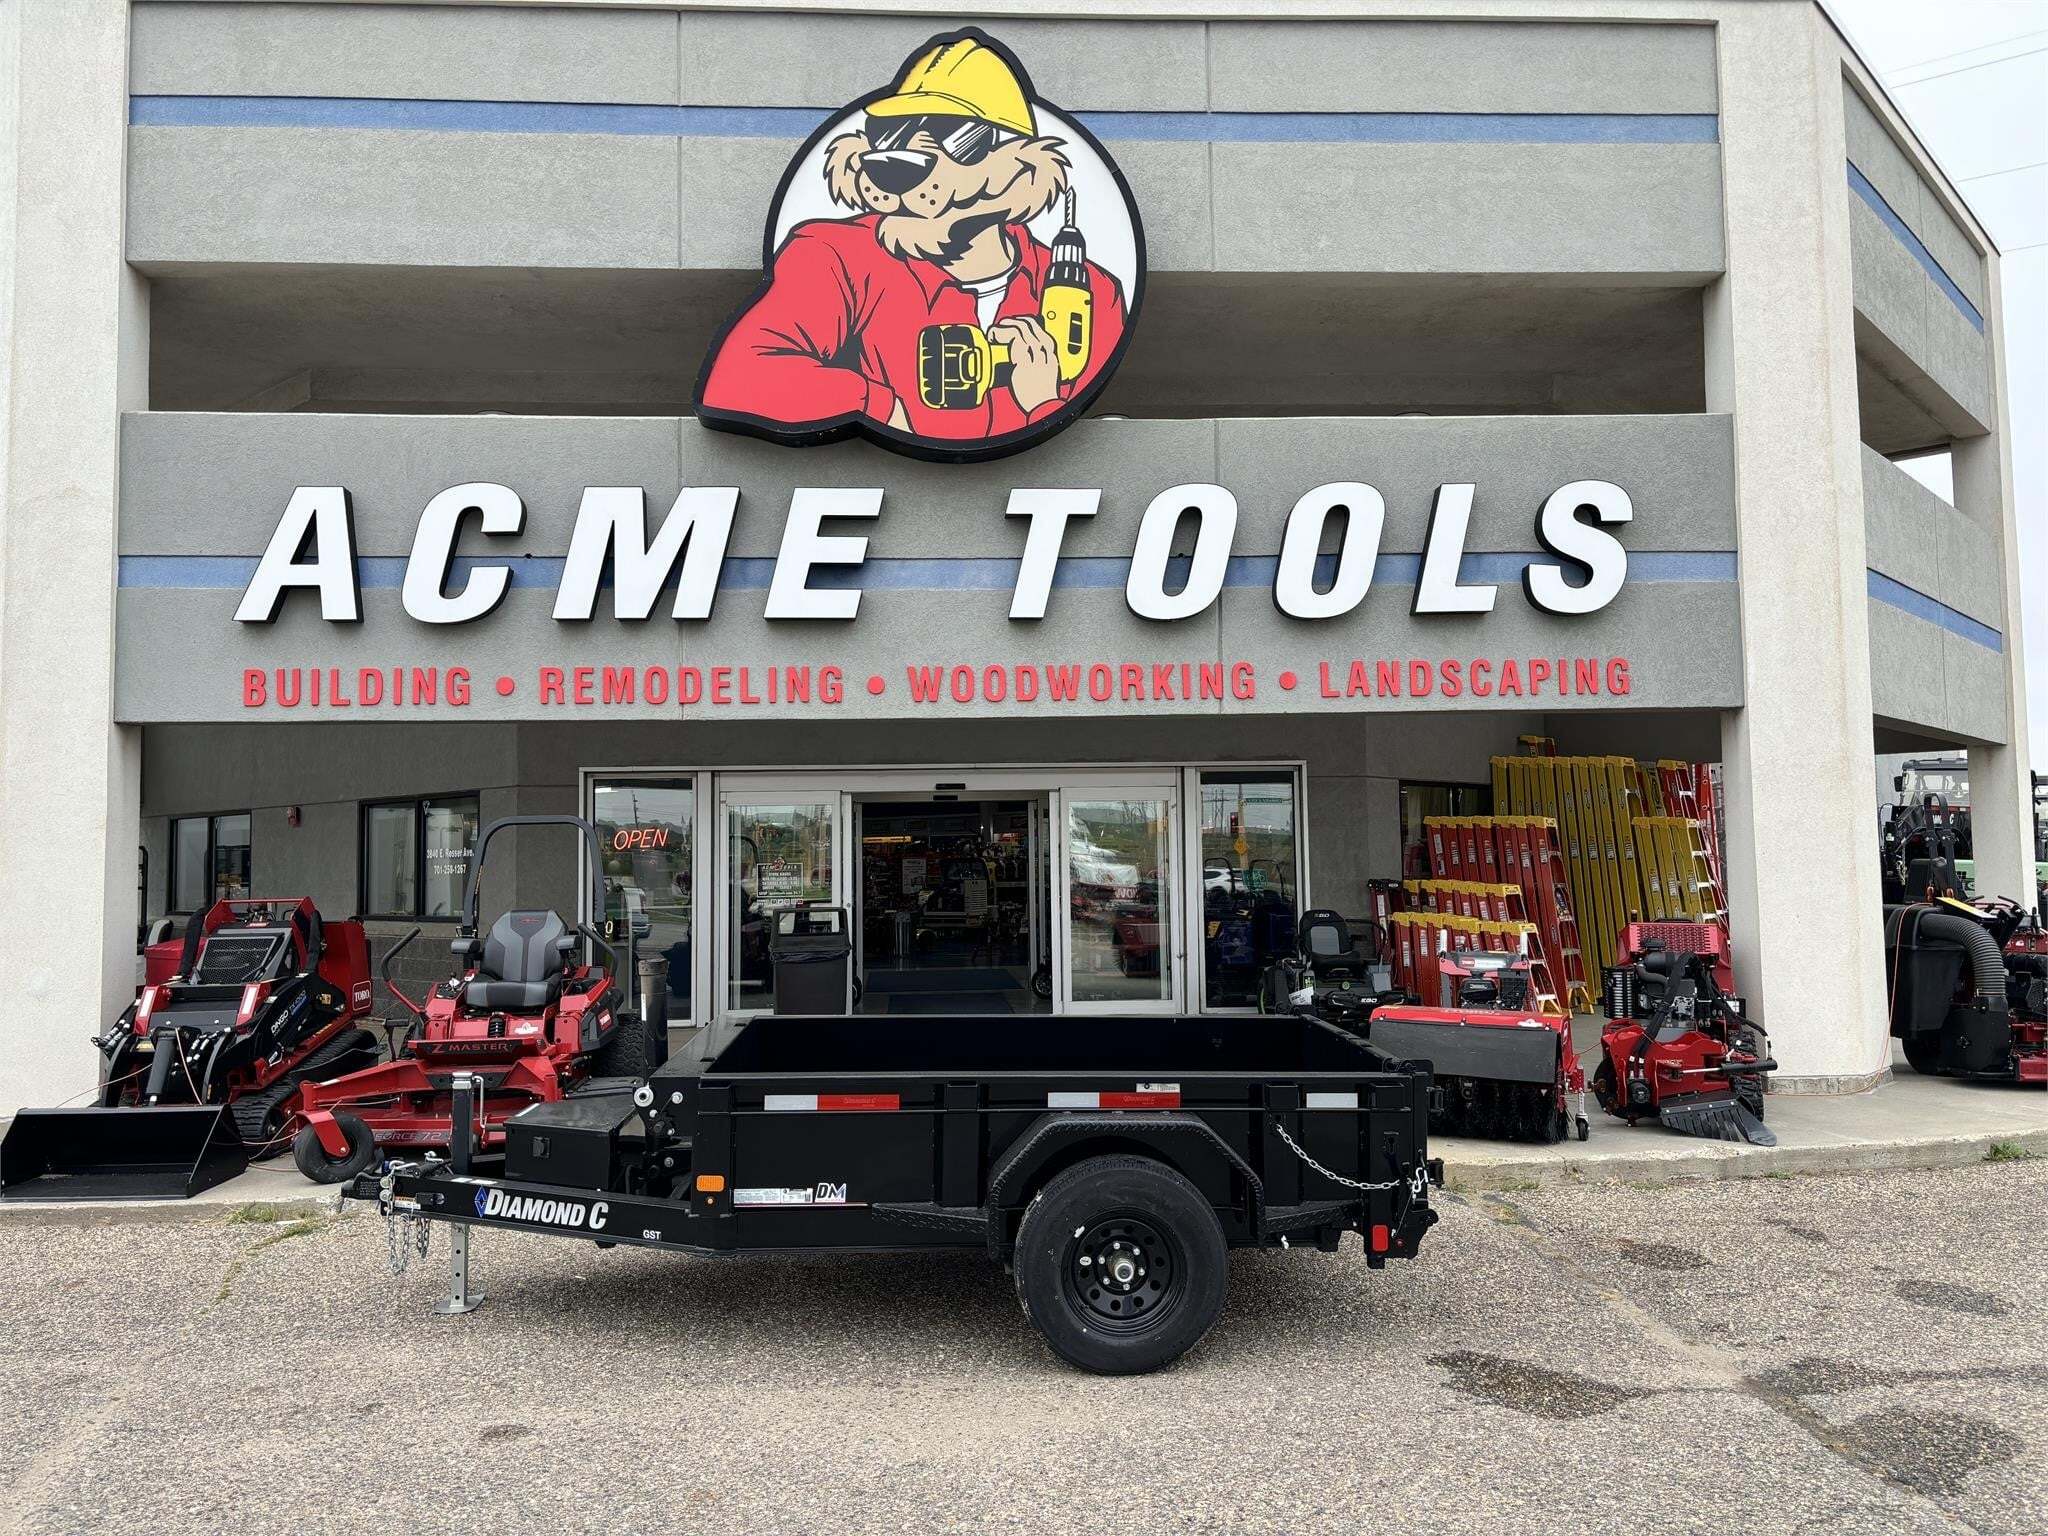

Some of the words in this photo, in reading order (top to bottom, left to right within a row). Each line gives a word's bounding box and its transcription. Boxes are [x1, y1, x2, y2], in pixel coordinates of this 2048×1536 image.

[233, 482, 885, 624] ACME
[1005, 480, 1633, 621] TOOLS
[243, 667, 470, 707] BUILDING
[540, 665, 844, 705] REMODELING
[907, 661, 1256, 703] WOODWORKING
[1320, 657, 1632, 700] LANDSCAPING
[613, 827, 669, 850] OPEN
[354, 989, 370, 1002] TORO
[432, 1043, 446, 1053] Z
[448, 1042, 509, 1052] MASTER
[422, 1131, 443, 1141] 72
[484, 1188, 585, 1227] DIAMOND
[588, 1201, 609, 1230] C
[643, 1229, 662, 1240] GST
